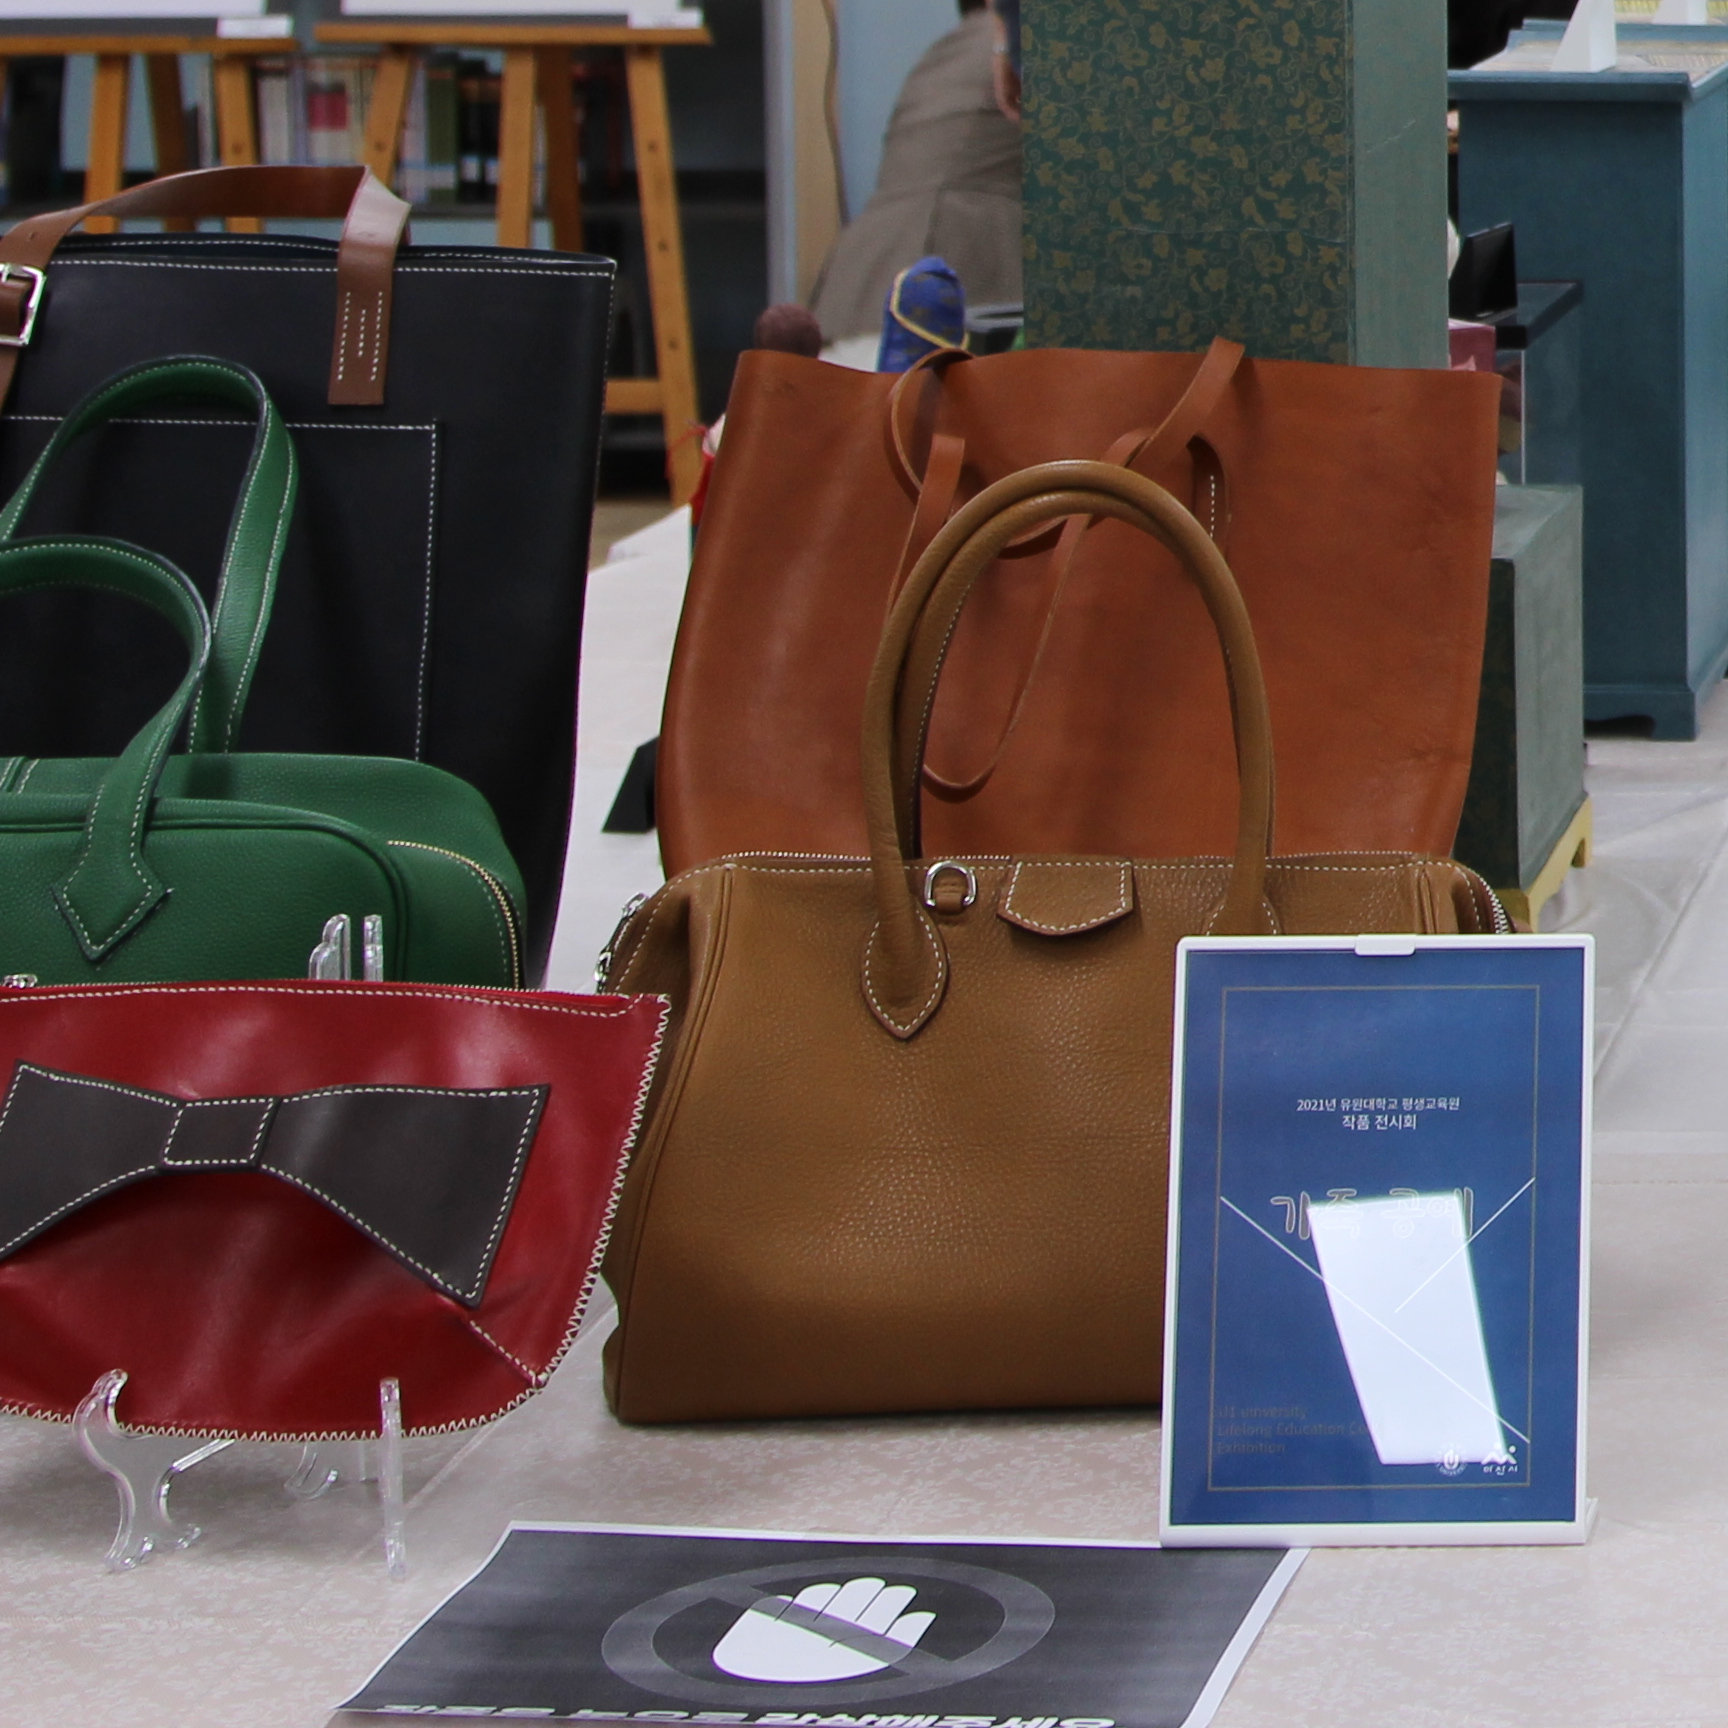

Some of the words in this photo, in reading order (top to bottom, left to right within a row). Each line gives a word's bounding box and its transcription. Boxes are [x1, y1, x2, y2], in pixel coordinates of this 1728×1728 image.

[1296, 1098, 1336, 1112] 2021년
[1340, 1097, 1398, 1112] 유원대학교
[1402, 1096, 1461, 1111] 평생교육원
[1342, 1114, 1370, 1131] 작품
[1374, 1113, 1417, 1131] 전시회
[1270, 1187, 1364, 1240] 가족
[1379, 1186, 1474, 1239] 공예
[1218, 1423, 1272, 1438] Lifelong
[1277, 1422, 1344, 1436] Education
[1217, 1441, 1286, 1454] Exhibition
[1483, 1464, 1518, 1476] 아산시
